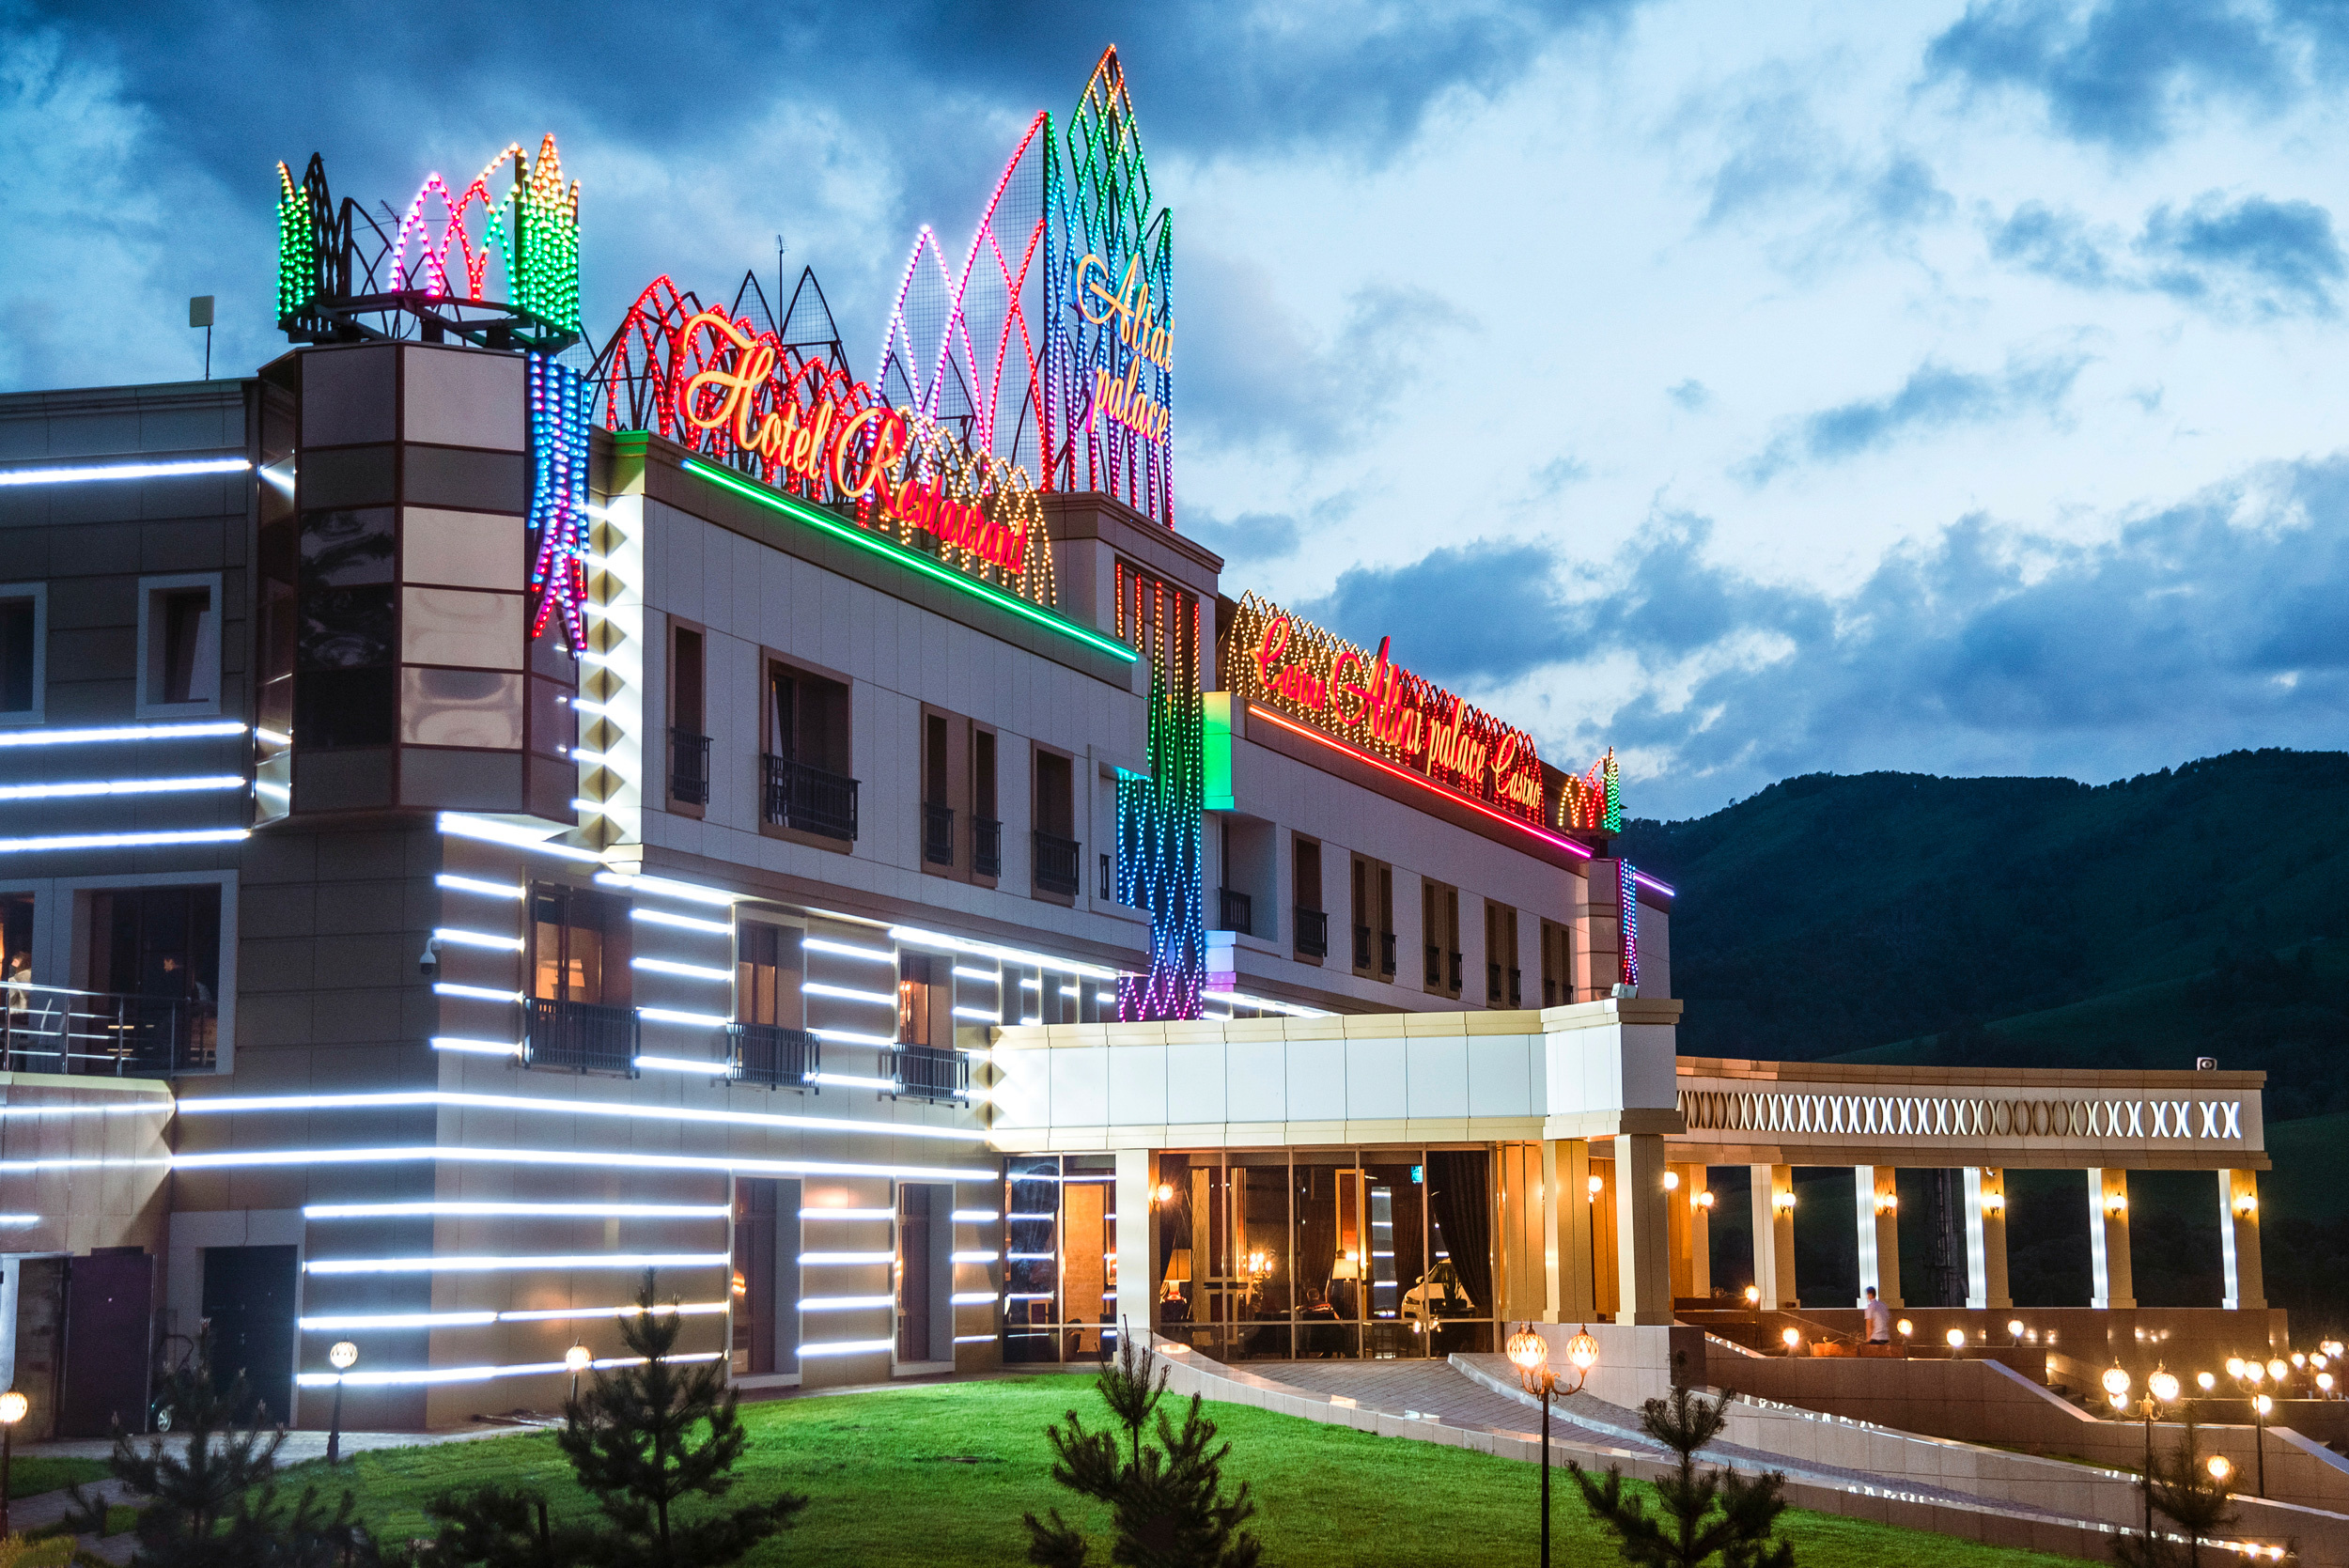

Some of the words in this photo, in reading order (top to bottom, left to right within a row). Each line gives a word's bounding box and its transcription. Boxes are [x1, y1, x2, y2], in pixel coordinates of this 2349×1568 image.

[1073, 253, 1175, 373] Altai
[679, 312, 834, 481] Hotel
[831, 407, 1029, 576] Restaurant
[1086, 354, 1169, 446] palace
[1250, 615, 1327, 712] Casino
[1329, 635, 1423, 754] Altai
[1426, 697, 1486, 778] palace
[1491, 733, 1542, 810] Casino
